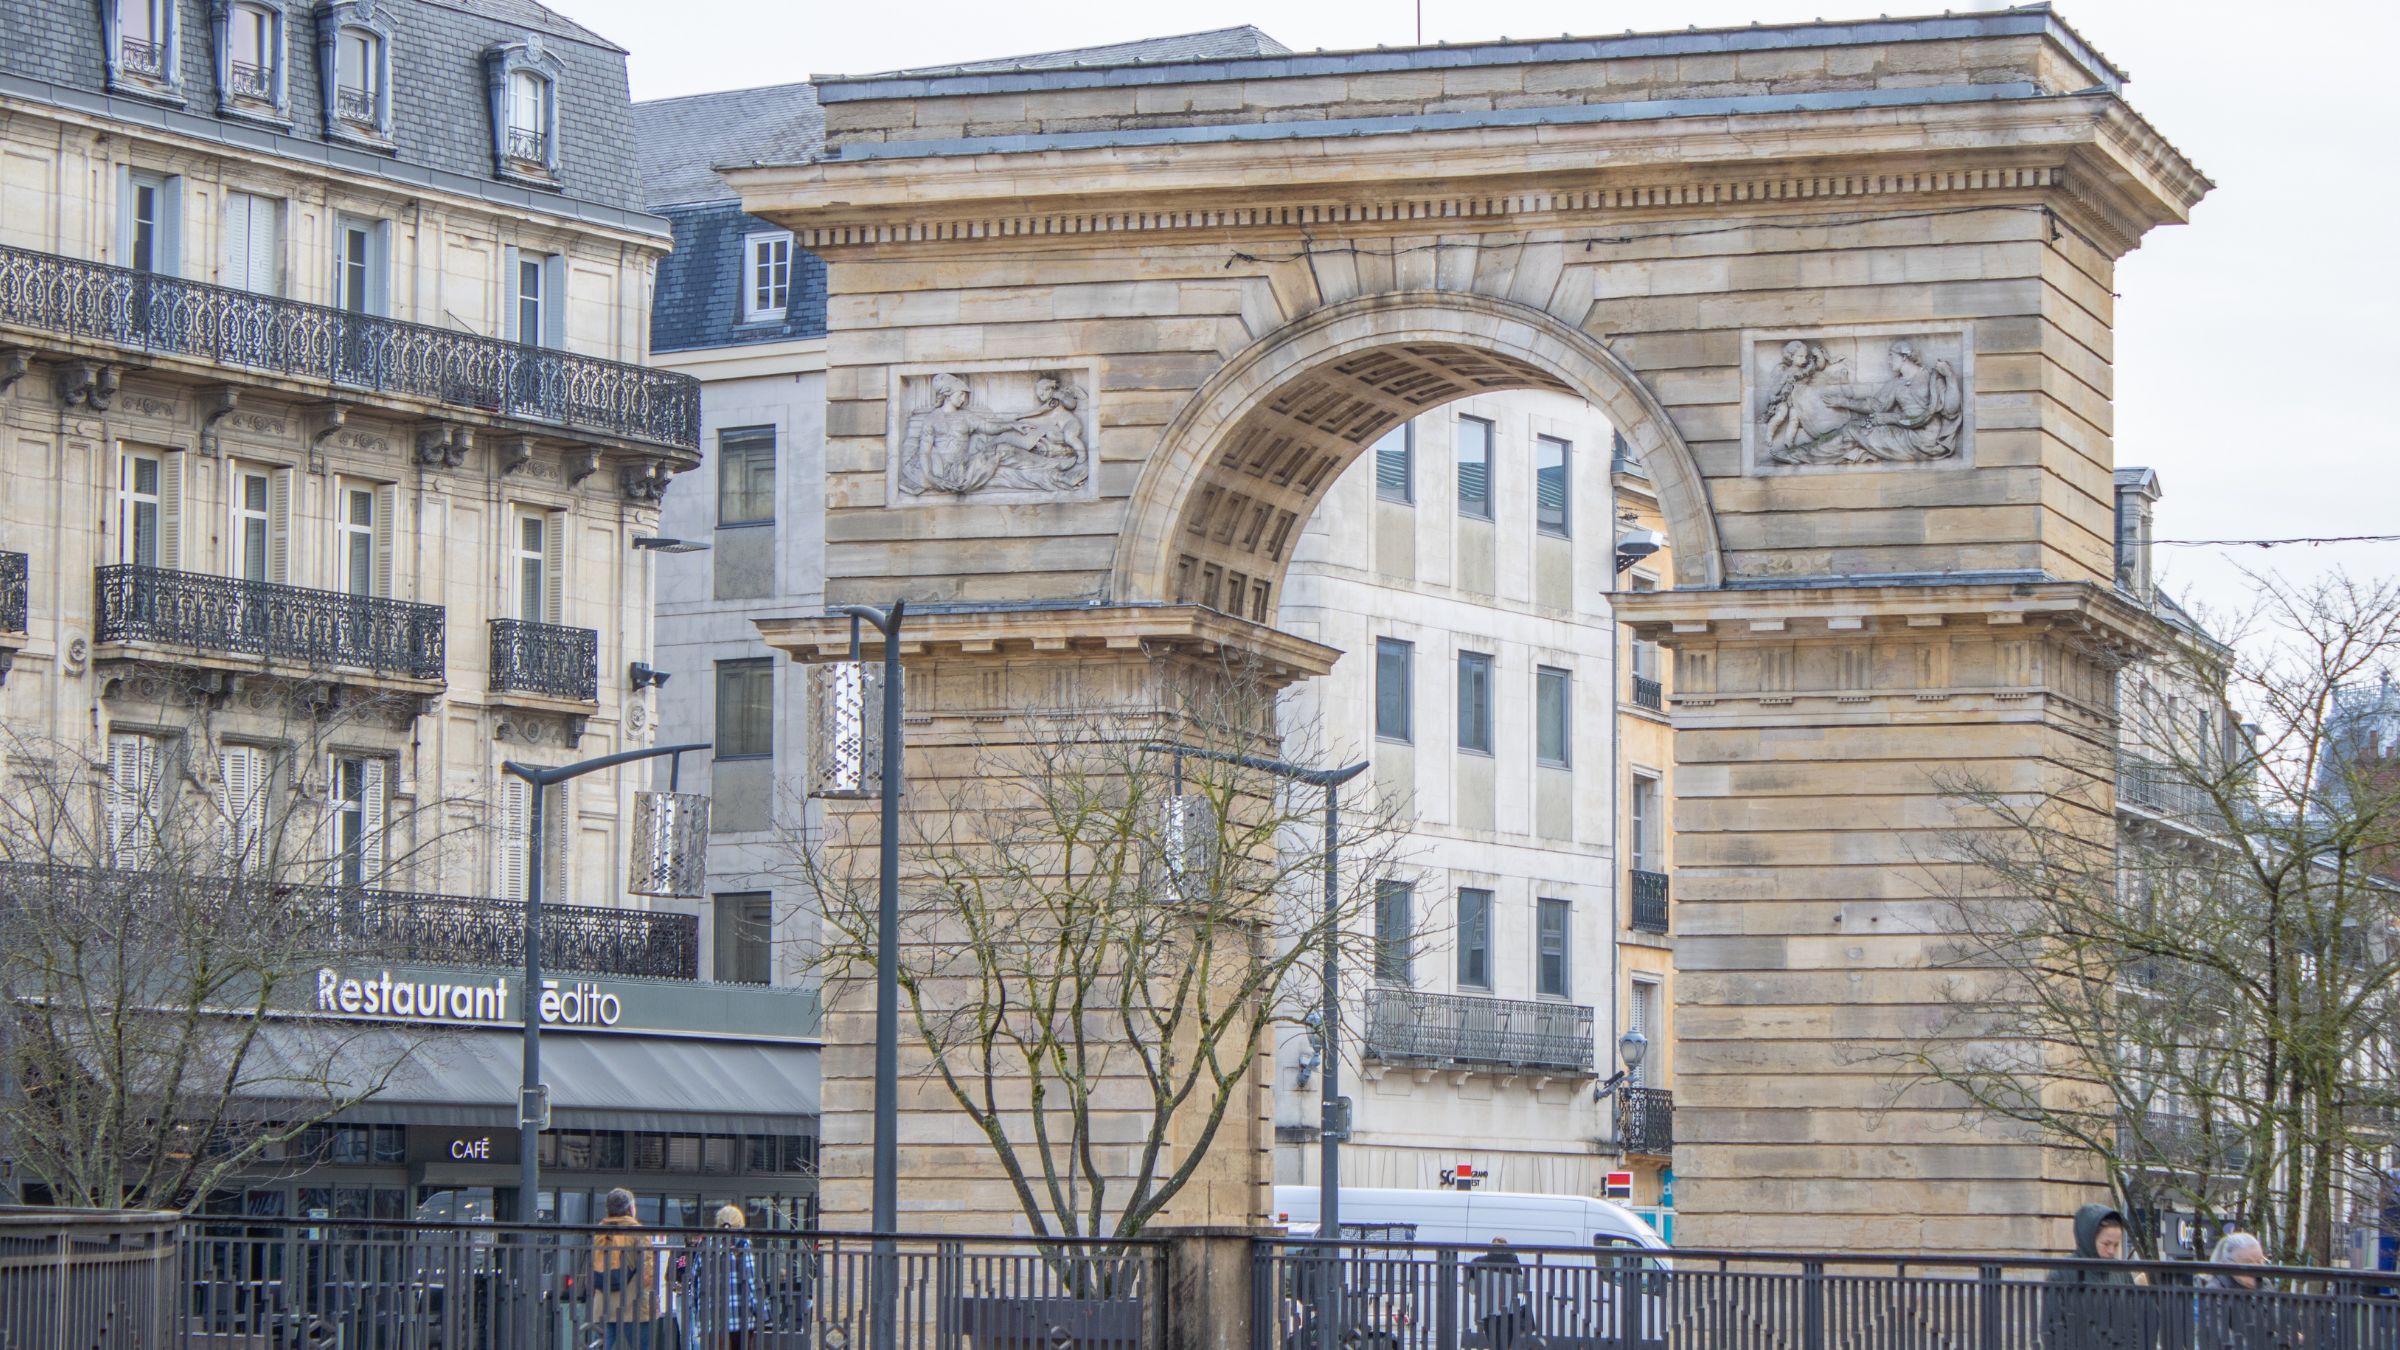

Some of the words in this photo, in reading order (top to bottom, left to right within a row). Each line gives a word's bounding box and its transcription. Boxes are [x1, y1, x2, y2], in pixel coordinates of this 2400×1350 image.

[317, 968, 508, 1020] Restaurant
[451, 1137, 490, 1159] CAFÉ
[1440, 1170, 1455, 1186] SG
[1471, 1179, 1481, 1187] EST
